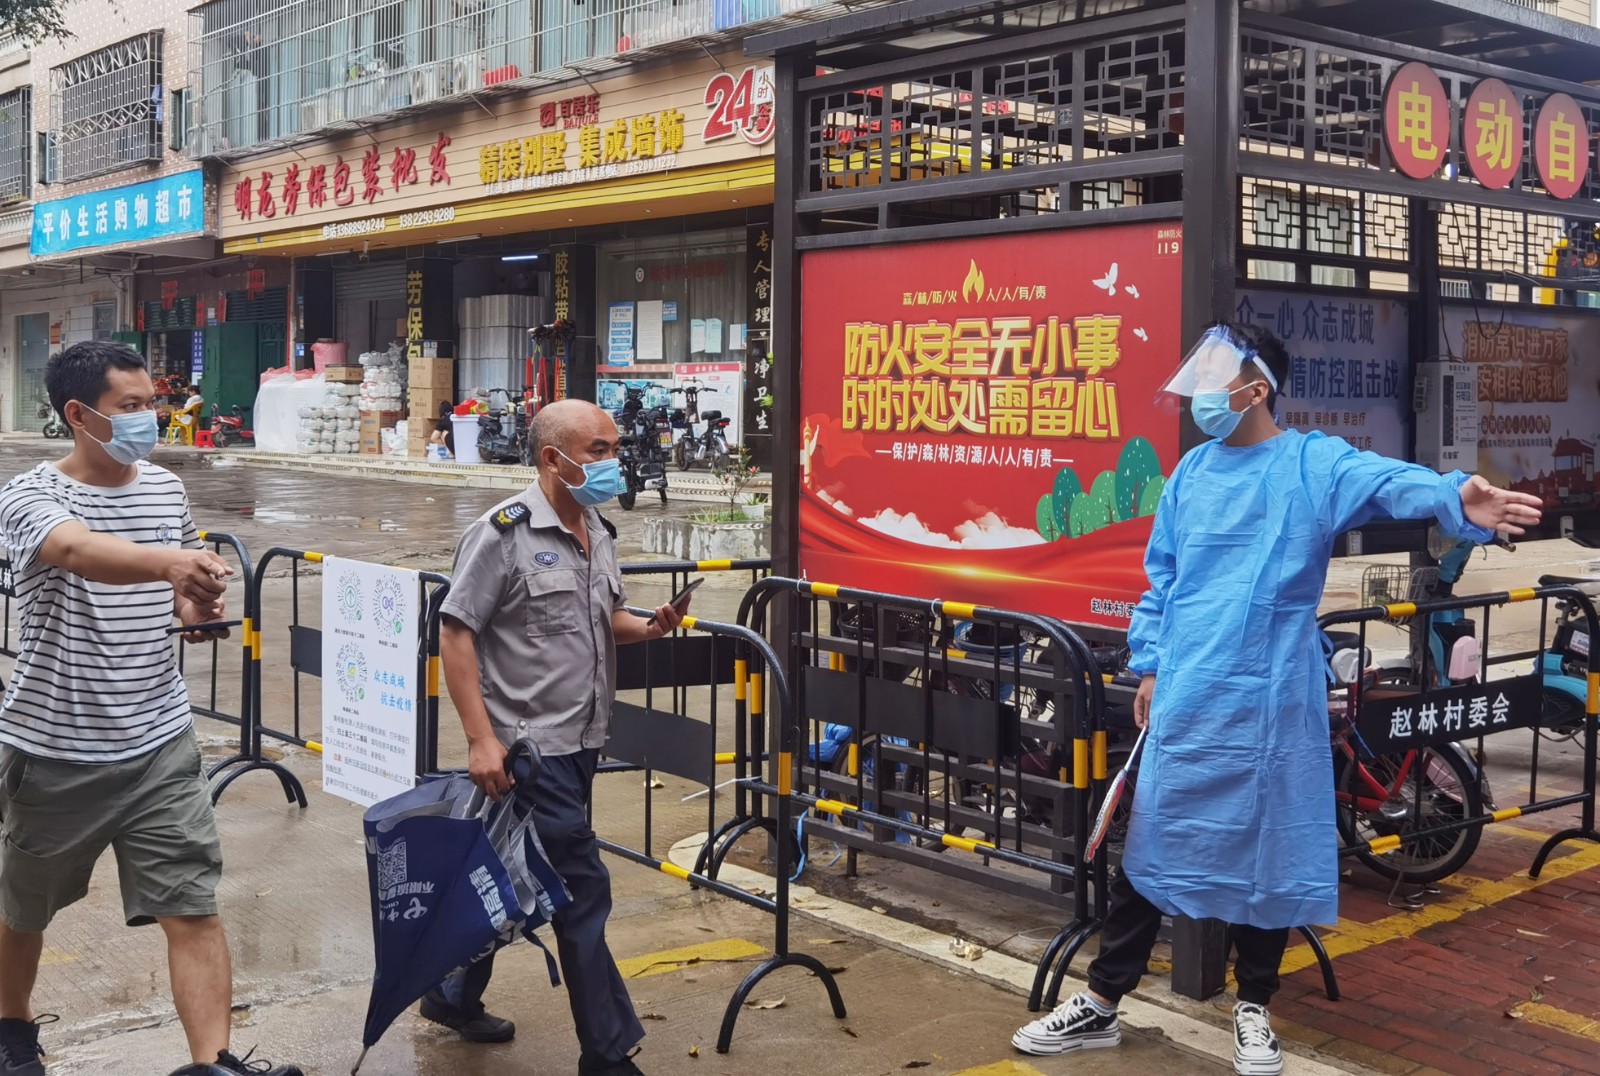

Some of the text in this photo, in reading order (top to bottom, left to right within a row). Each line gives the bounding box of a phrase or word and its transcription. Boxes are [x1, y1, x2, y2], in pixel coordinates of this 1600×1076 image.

[560, 93, 601, 119] 百居乐
[702, 65, 757, 142] 24
[478, 106, 686, 184] 精装别墅 集成墙饰
[234, 132, 452, 221] 明龙劳保包装批发
[41, 183, 194, 244] 平价生活购物超市
[1157, 241, 1180, 255] 119
[843, 313, 1122, 376] 防火安全无小事
[1302, 299, 1375, 345] 众志成城
[1464, 322, 1568, 362] 消防常识进万家
[1277, 355, 1399, 400] 情防控阻击战
[841, 376, 1121, 439] 时时处处需留心
[1388, 691, 1511, 740] 赵林村委会
